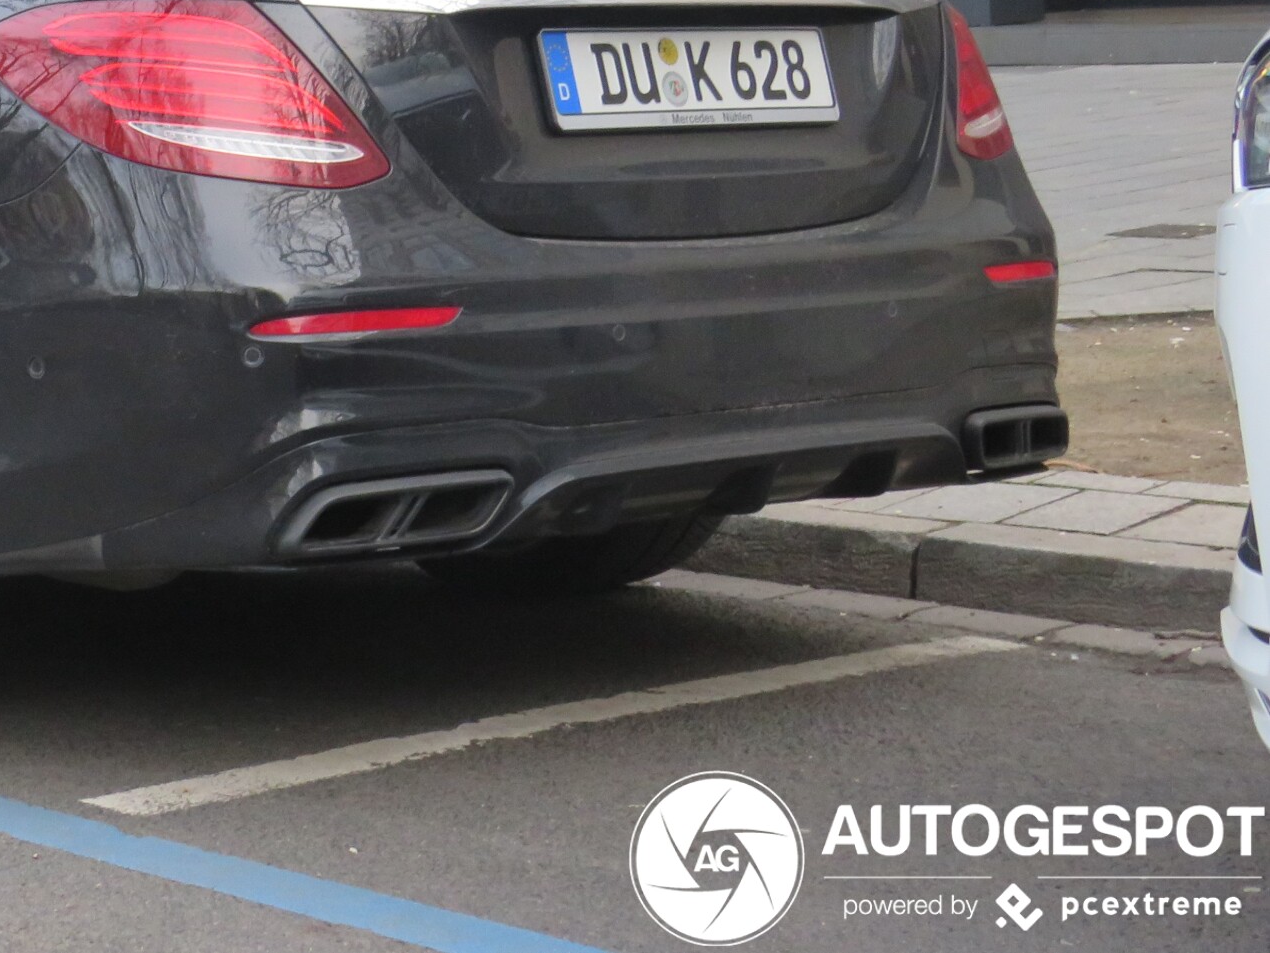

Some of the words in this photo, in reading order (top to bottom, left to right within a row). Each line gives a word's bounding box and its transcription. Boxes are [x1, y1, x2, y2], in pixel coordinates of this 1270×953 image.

[590, 41, 662, 106] DU
[683, 40, 724, 102] K
[730, 39, 812, 101] 628
[558, 82, 571, 101] D
[671, 113, 716, 125] Mercedes
